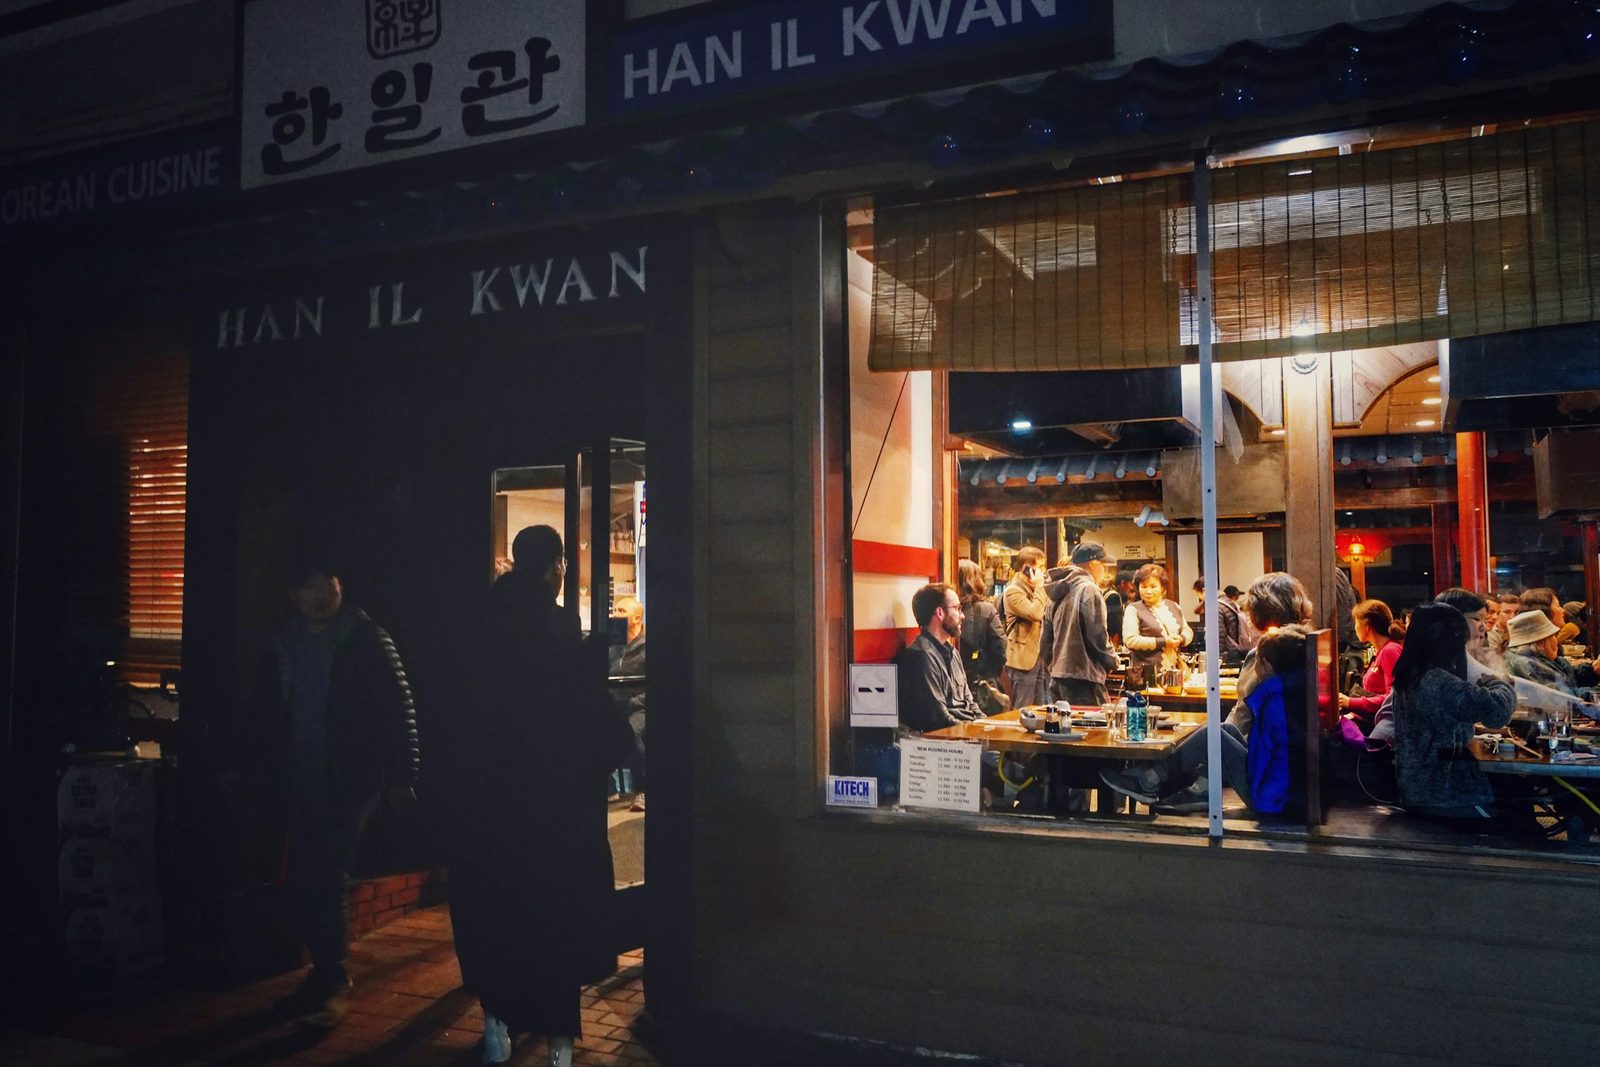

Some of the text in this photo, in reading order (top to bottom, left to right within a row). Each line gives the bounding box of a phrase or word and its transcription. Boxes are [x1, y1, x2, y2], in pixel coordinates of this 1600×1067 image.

[623, 31, 743, 99] HAN
[771, 18, 816, 71] IL
[261, 37, 561, 176] 한일관
[107, 146, 221, 205] CUISINE
[217, 246, 649, 350] HAN IL KWAN
[834, 780, 869, 797] KITECH
